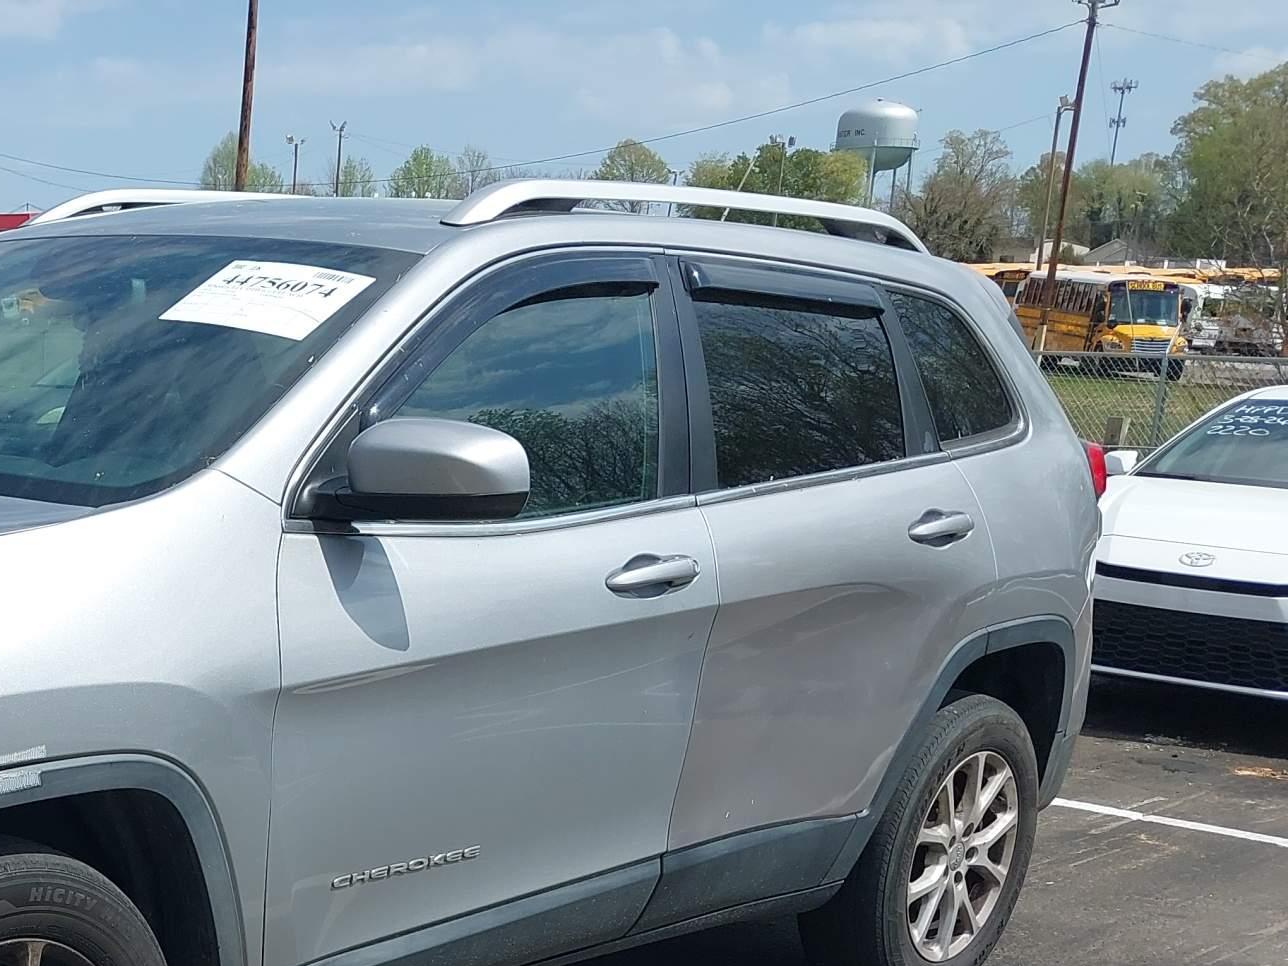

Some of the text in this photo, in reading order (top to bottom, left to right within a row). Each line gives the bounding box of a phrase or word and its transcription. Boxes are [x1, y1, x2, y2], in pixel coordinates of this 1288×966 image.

[222, 273, 338, 298] 44756074
[1207, 425, 1270, 436] 2220
[332, 845, 481, 890] CHEROKEE
